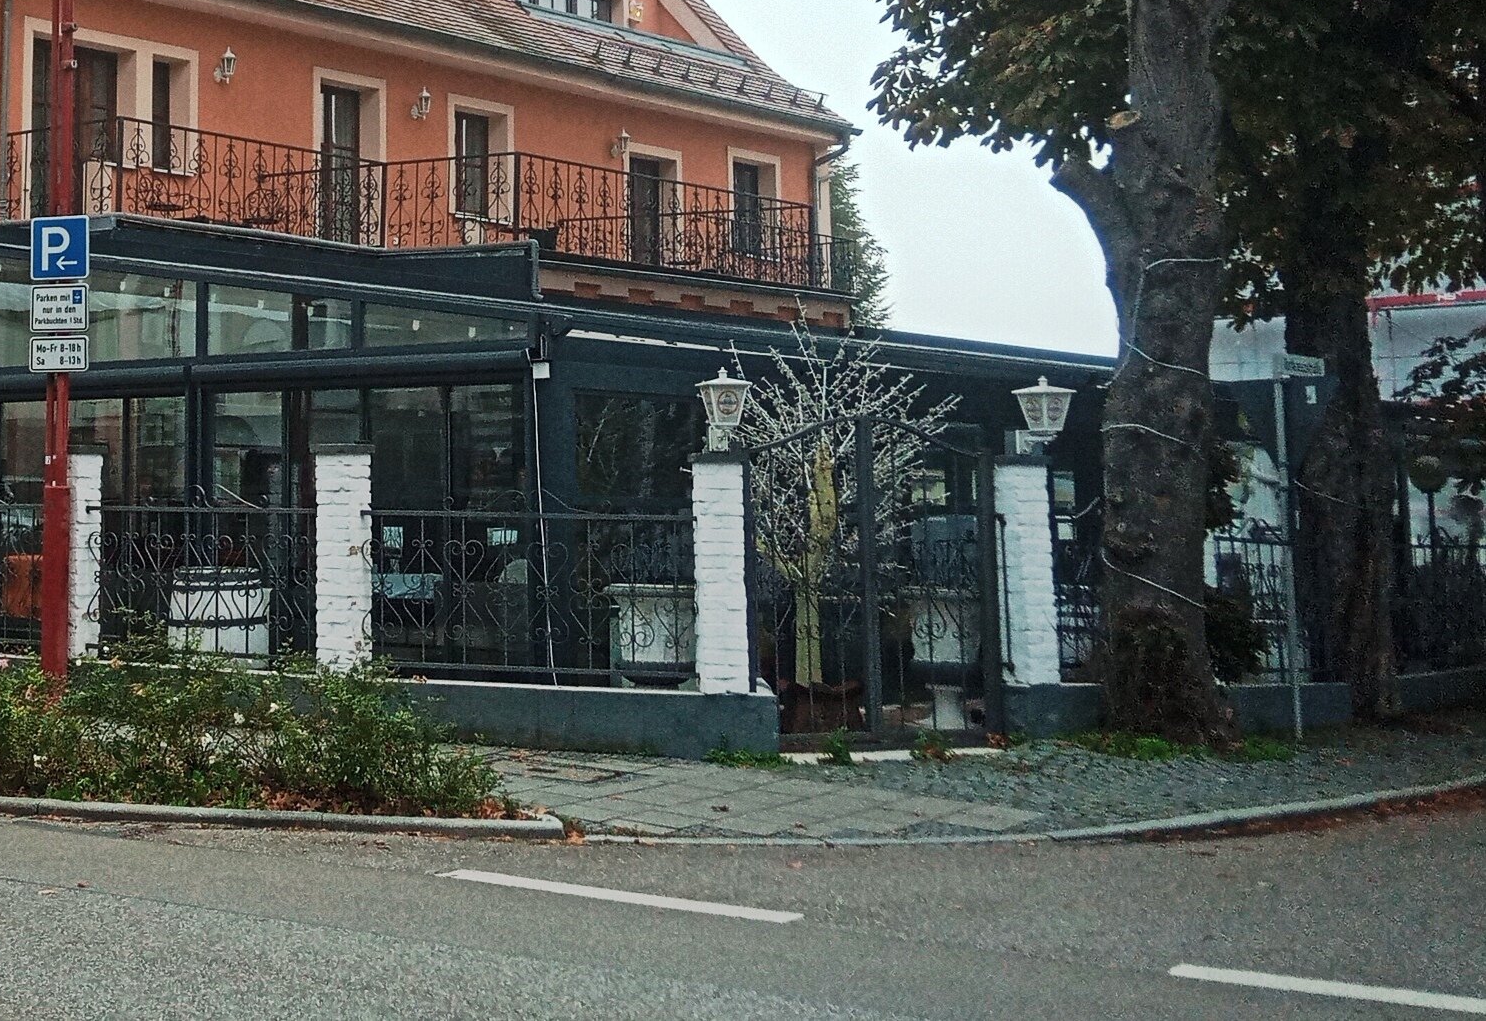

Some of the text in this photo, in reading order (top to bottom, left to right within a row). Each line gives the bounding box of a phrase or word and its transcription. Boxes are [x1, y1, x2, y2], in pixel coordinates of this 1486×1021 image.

[41, 226, 71, 271] P
[36, 293, 71, 302] Parken mit
[55, 306, 62, 314] in
[64, 305, 76, 314] den
[34, 317, 67, 325] Parkbuchten
[36, 343, 57, 353] Mo-Fr
[36, 356, 46, 366] Sa
